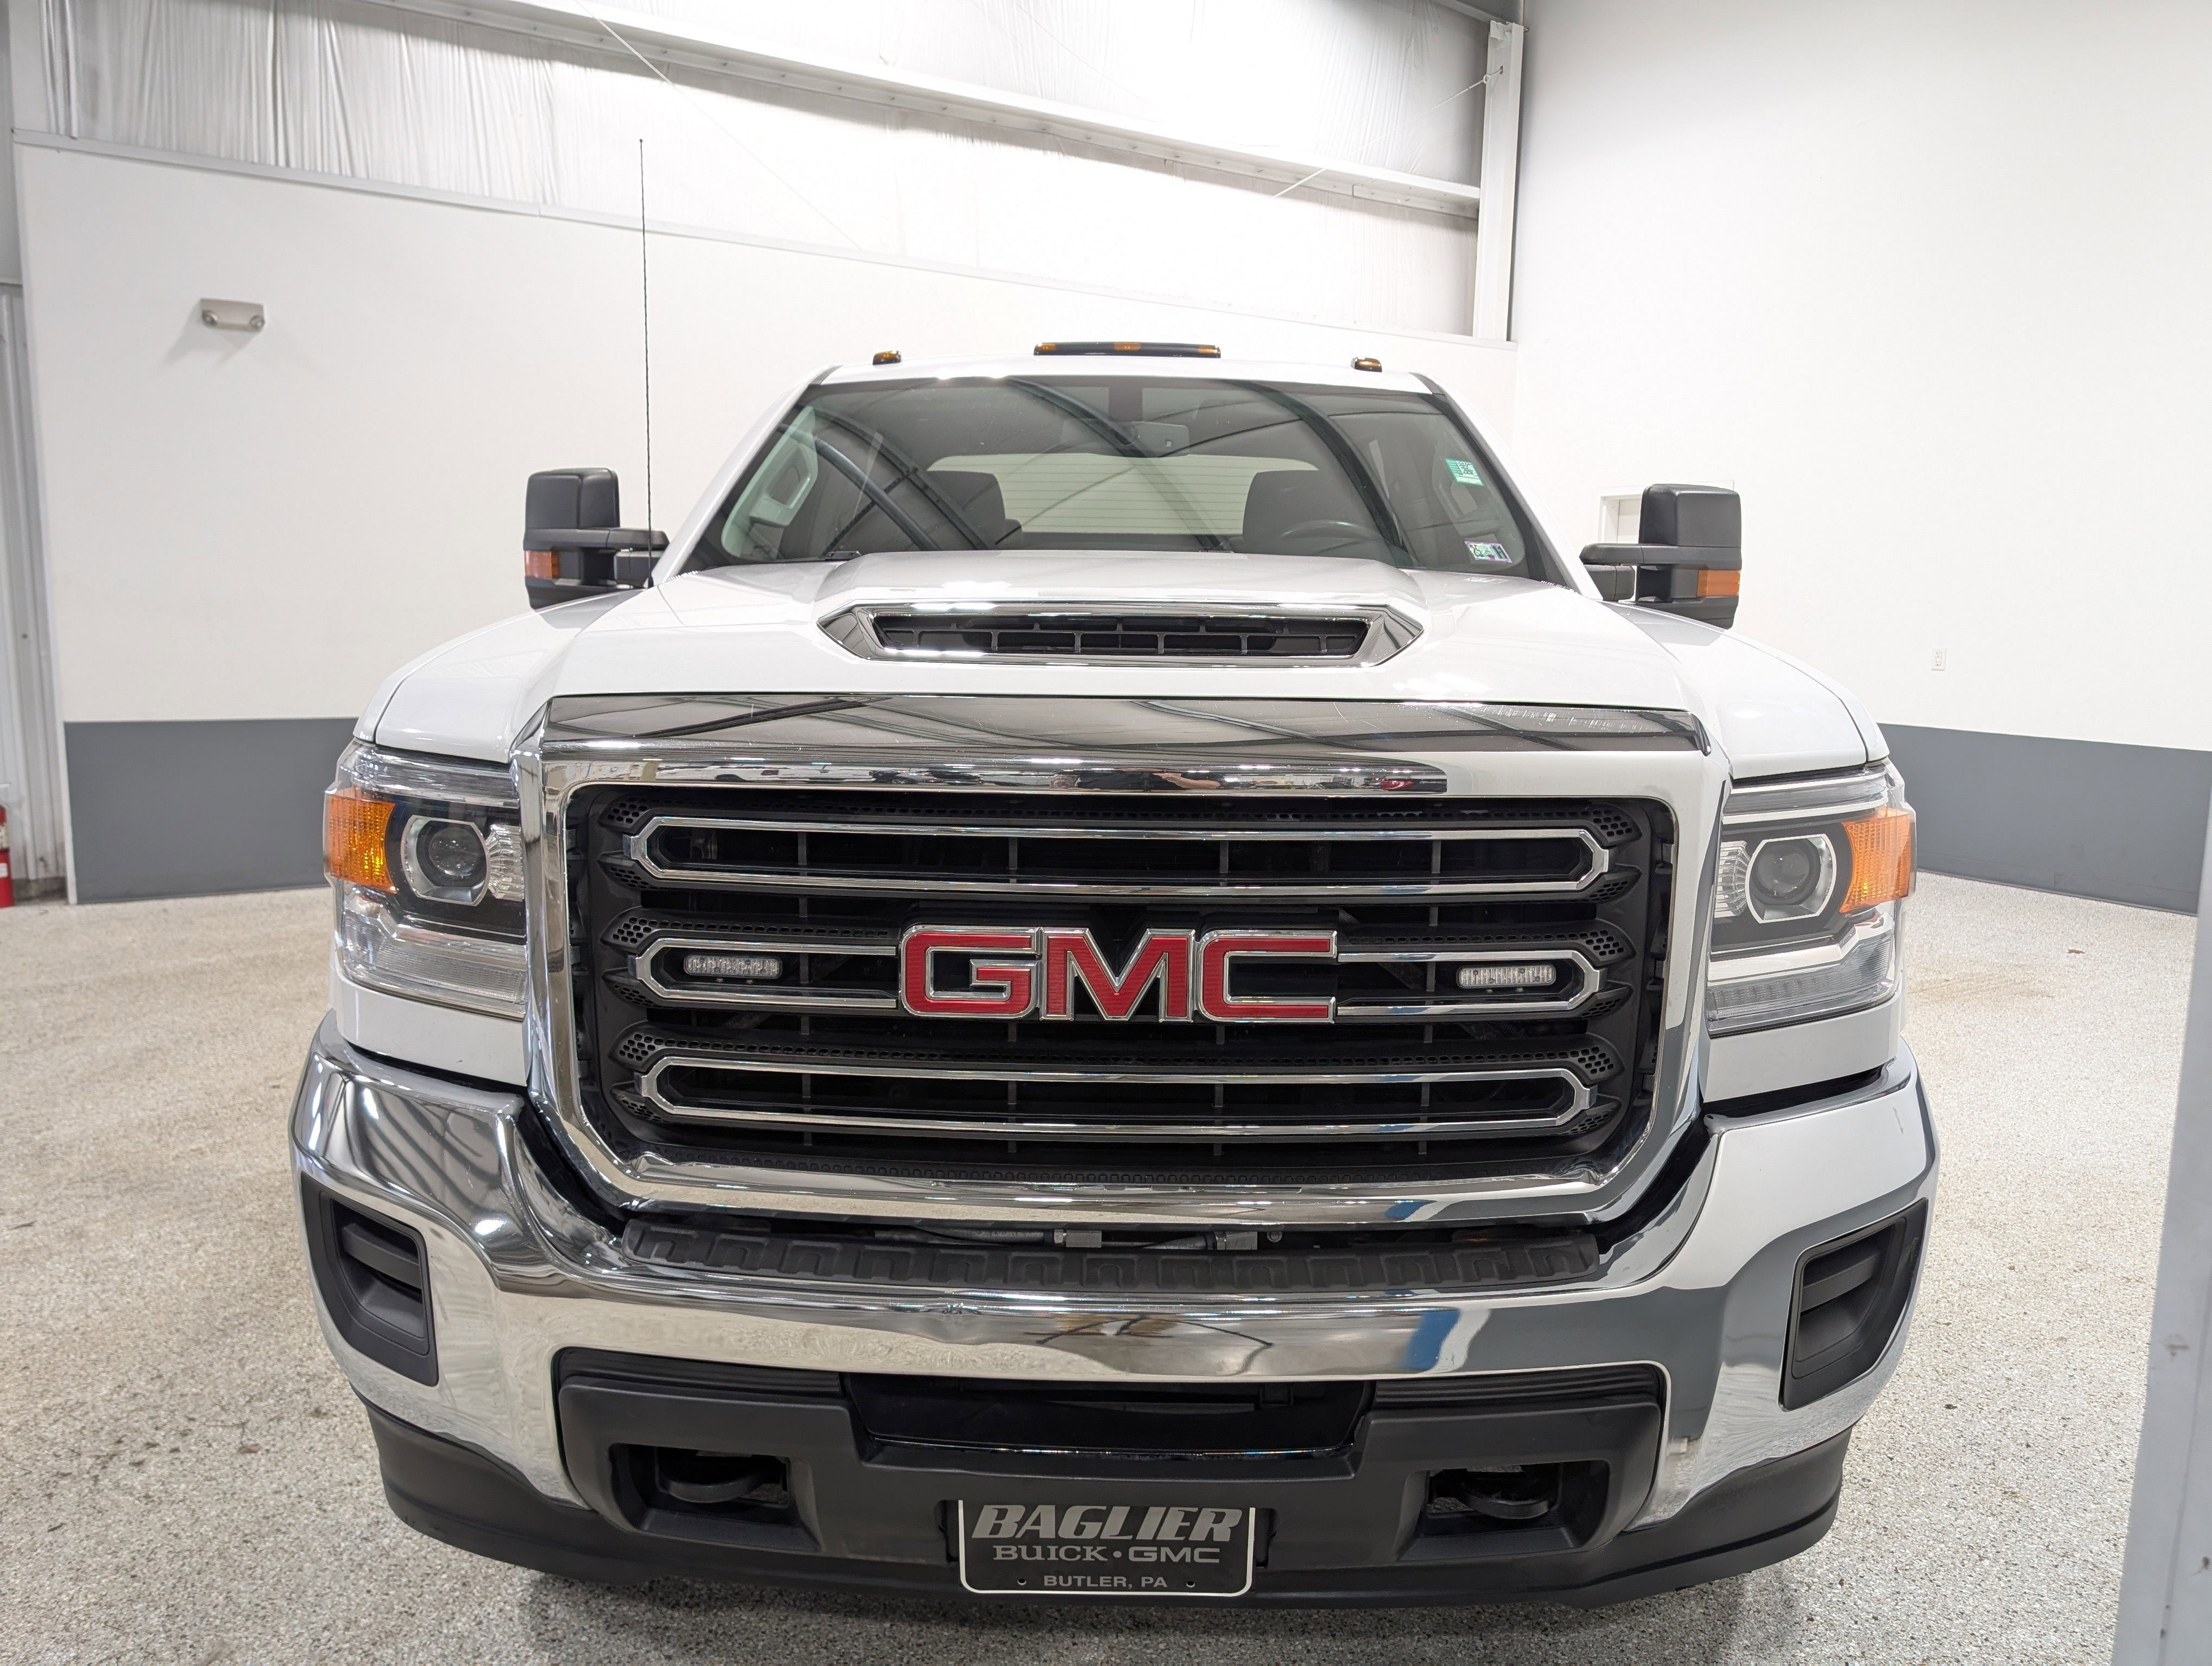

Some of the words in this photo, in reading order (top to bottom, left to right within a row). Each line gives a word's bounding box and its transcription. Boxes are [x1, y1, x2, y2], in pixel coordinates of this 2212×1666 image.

[899, 925, 1337, 1023] GMC
[972, 1504, 1243, 1541] BAGLIER
[993, 1545, 1108, 1561] BUICK
[1128, 1546, 1220, 1563] GMC
[1044, 1575, 1133, 1589] BUTLER,
[1141, 1577, 1168, 1587] PA
